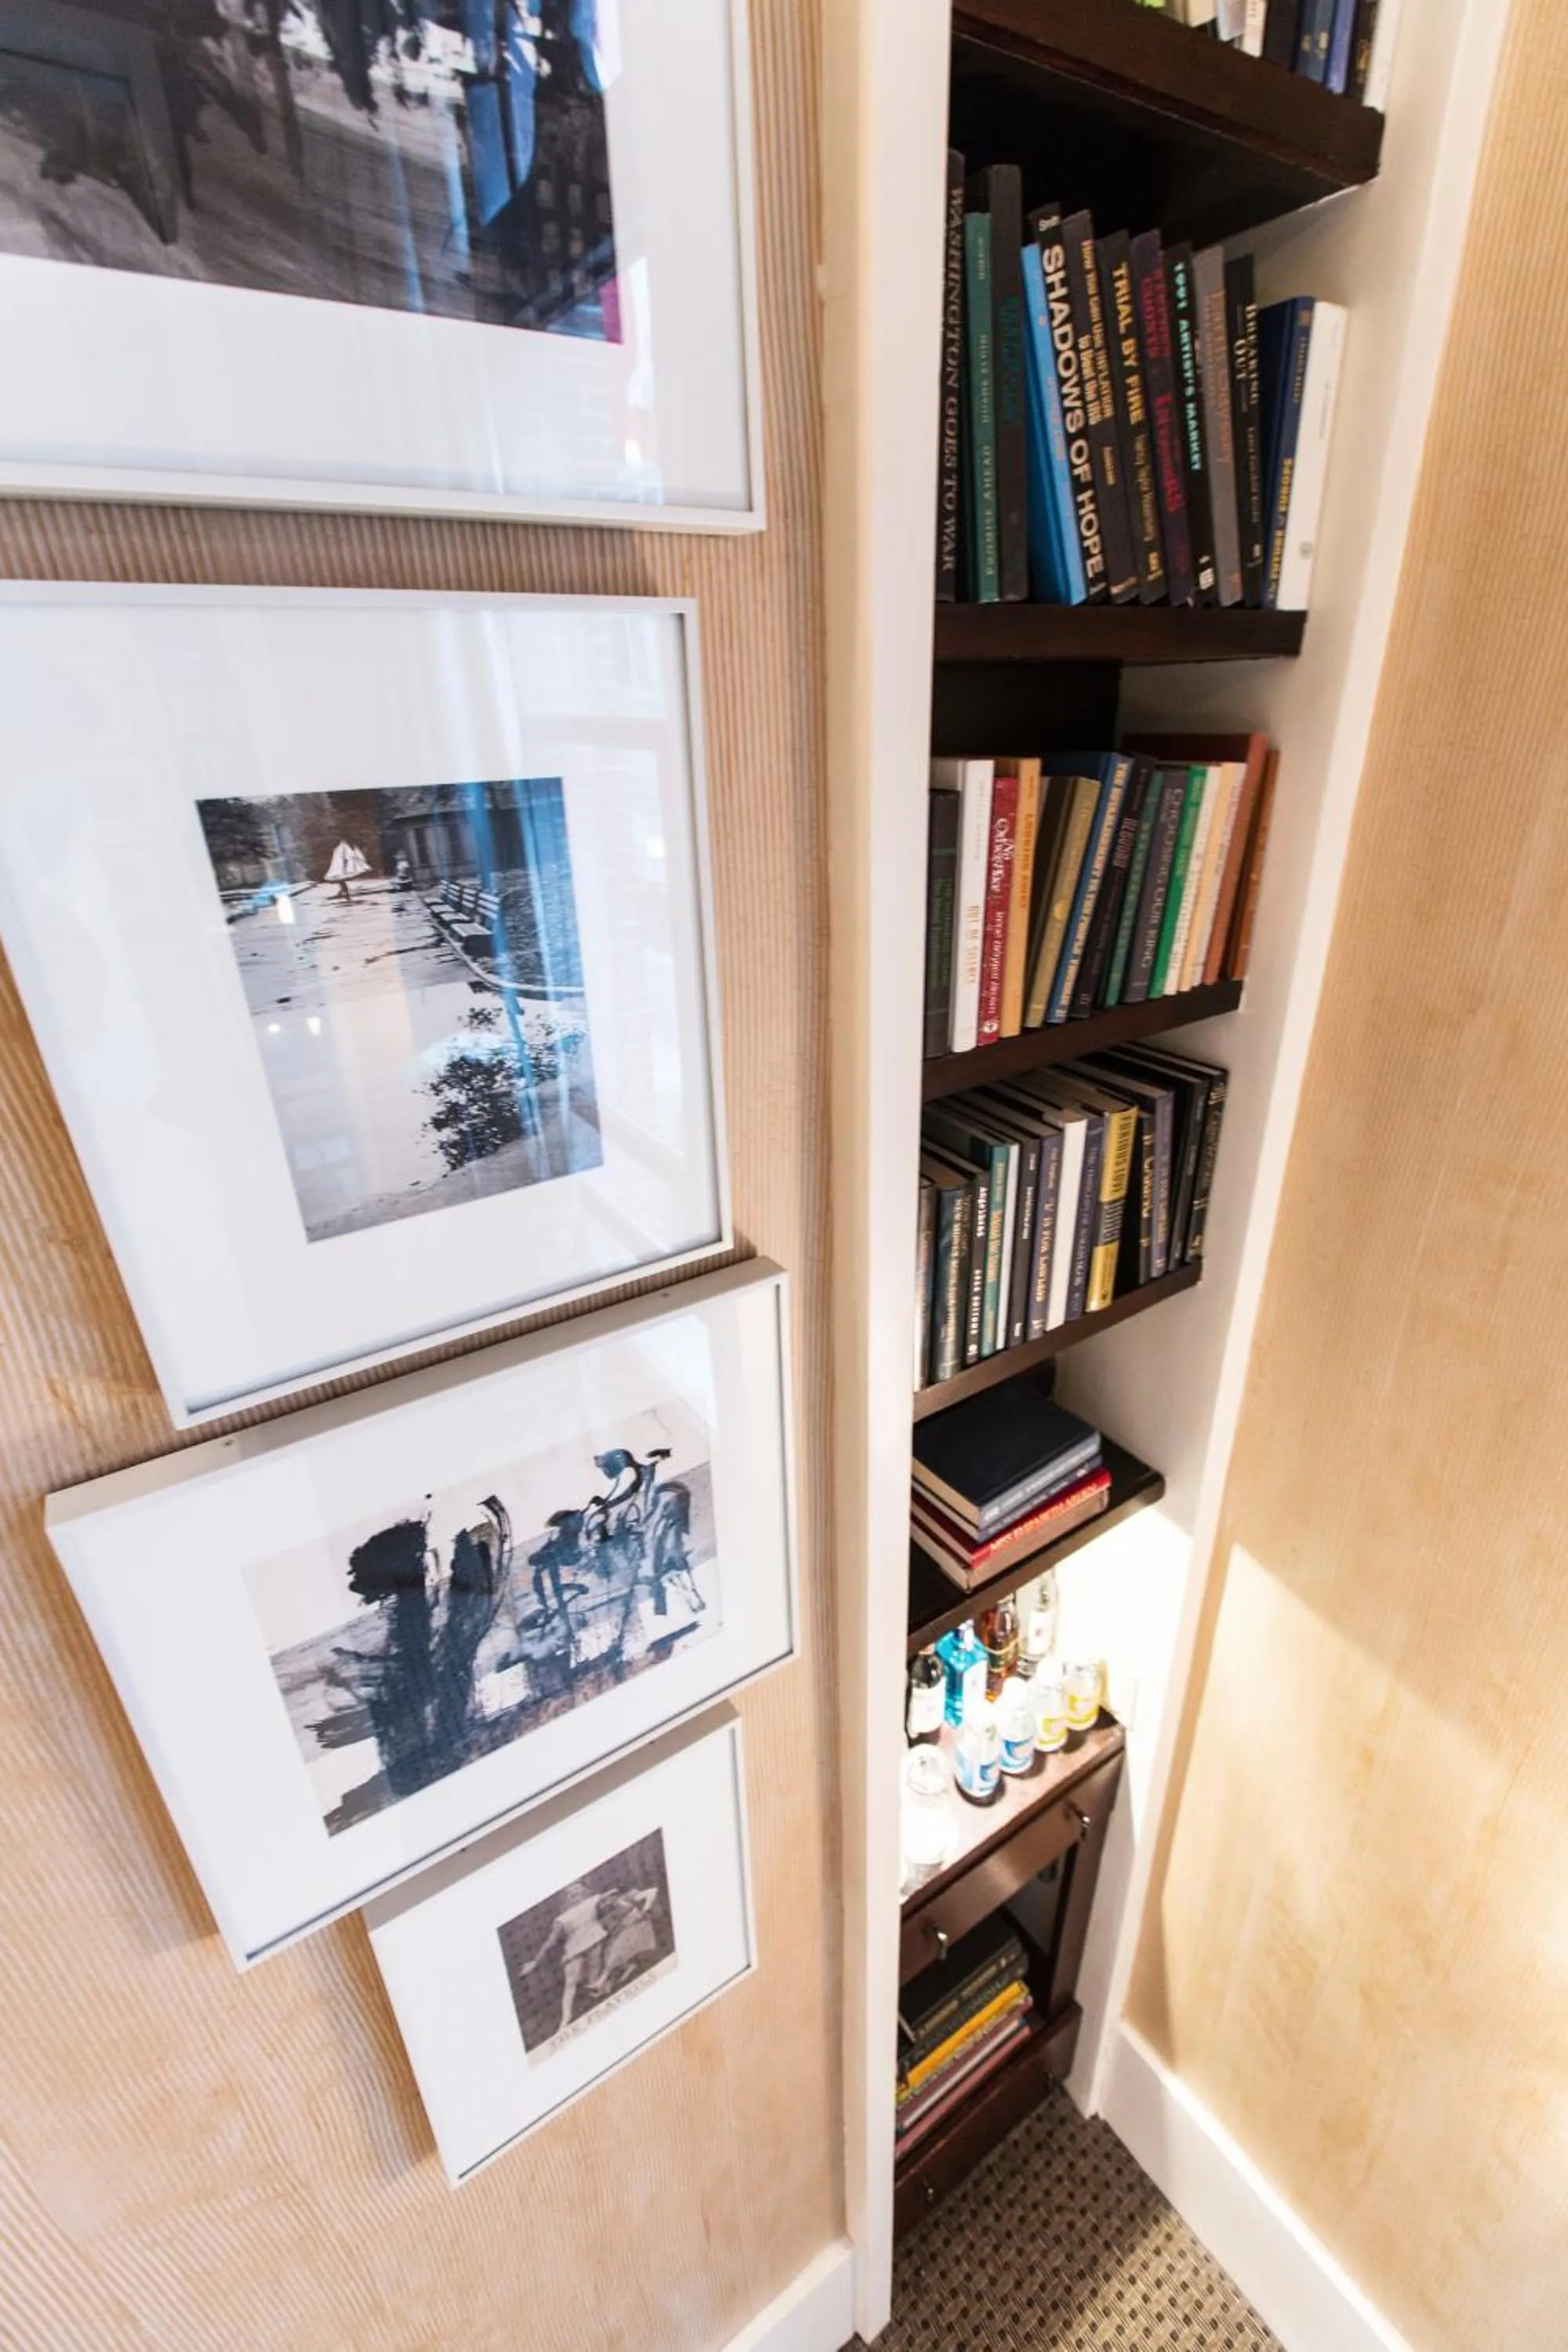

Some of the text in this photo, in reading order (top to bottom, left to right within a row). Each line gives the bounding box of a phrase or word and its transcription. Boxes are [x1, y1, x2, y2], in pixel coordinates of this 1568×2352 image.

[1081, 238, 1094, 270] How
[1085, 272, 1098, 296] You
[1043, 244, 1086, 433] SHADOWS
[1112, 262, 1145, 425] TRIAL BY FIRE
[1174, 263, 1202, 470] 1991 ARTIST'S MARKET
[1233, 338, 1247, 379] OUT
[1245, 303, 1258, 405] BREAKING
[942, 187, 964, 571] WASHINGTON GOES TO WAR
[982, 445, 994, 499] AHEAD
[1070, 439, 1093, 483] OF
[1279, 457, 1293, 513] EUROPE
[1076, 489, 1105, 578] HOPE
[1156, 788, 1183, 884] CHOOSING
[1149, 887, 1165, 925] OUR
[1142, 929, 1158, 968] KING
